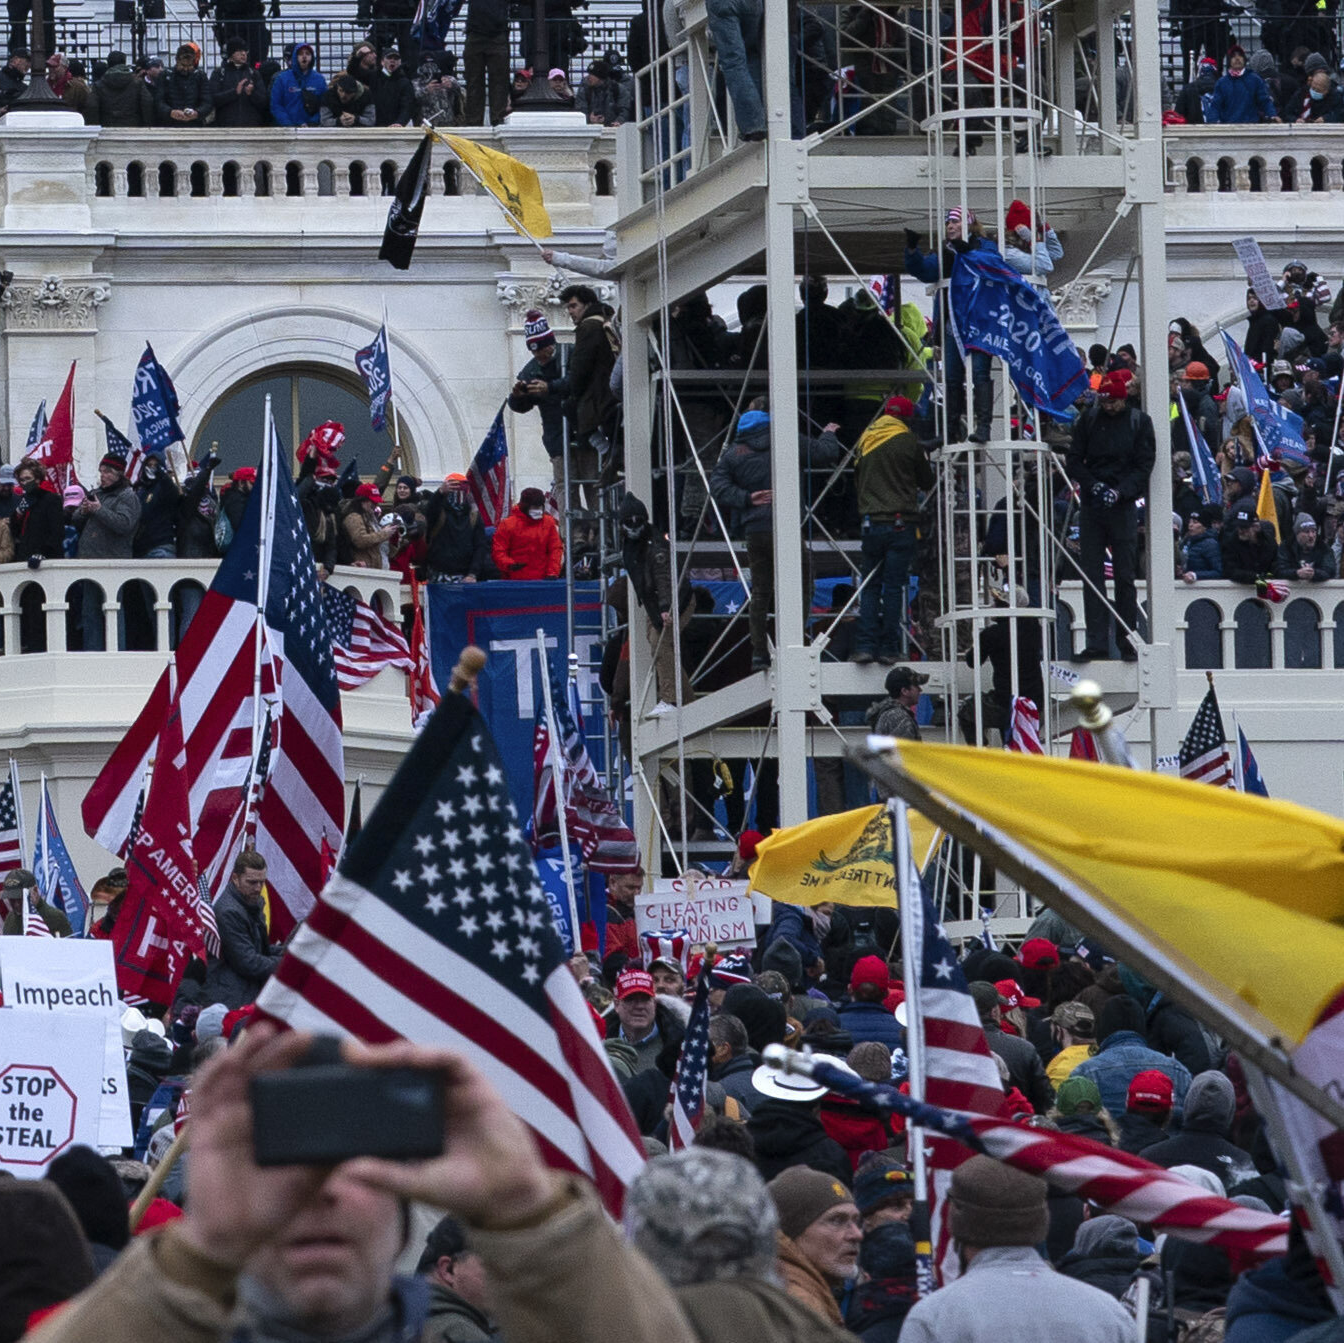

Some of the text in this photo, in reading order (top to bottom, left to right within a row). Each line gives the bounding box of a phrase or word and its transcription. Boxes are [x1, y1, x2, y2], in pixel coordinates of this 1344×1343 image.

[646, 897, 738, 919] CHEATING
[660, 912, 709, 930] LYING
[15, 981, 113, 1011] Impeach
[0, 1075, 57, 1097] STOP
[7, 1102, 44, 1122] the
